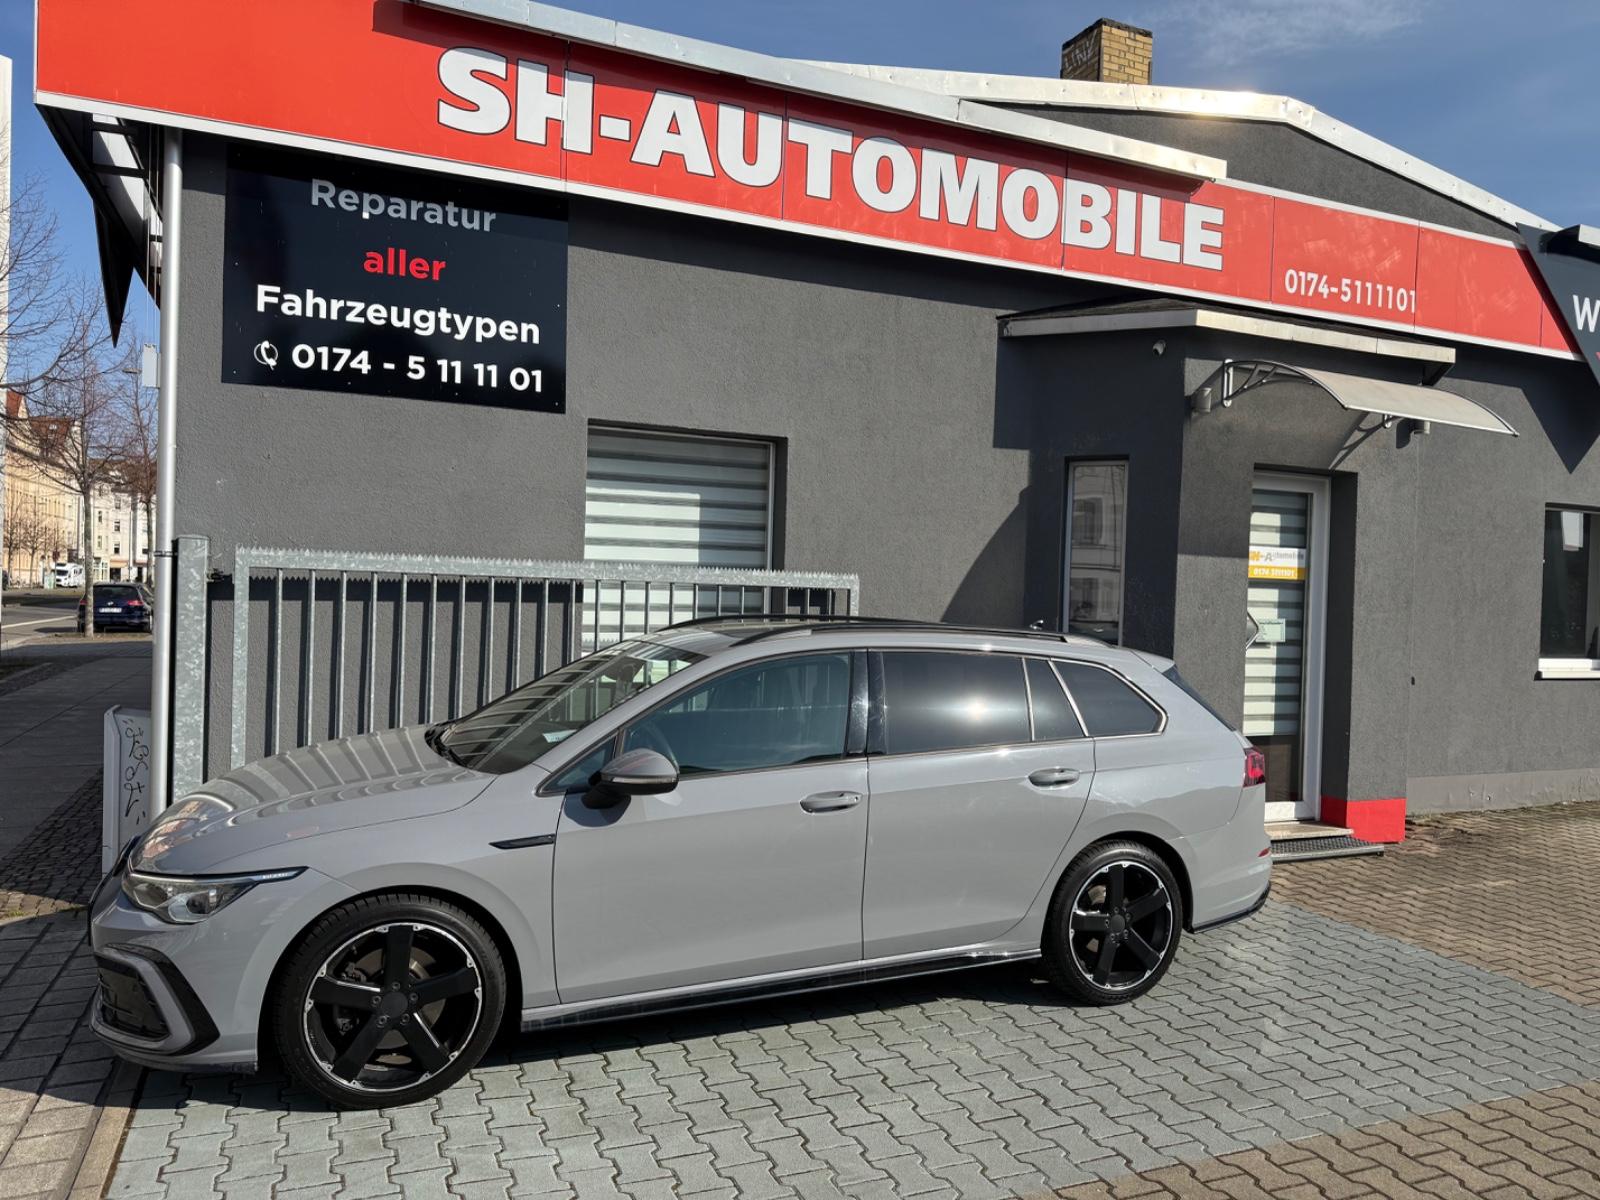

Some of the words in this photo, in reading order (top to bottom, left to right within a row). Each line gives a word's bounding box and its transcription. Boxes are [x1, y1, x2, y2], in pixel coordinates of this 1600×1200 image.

[437, 46, 1225, 271] SH-AUTOMOBILE
[311, 178, 497, 233] Reparatur
[363, 247, 447, 281] aller
[256, 284, 541, 344] Fahrzeugtypen
[1284, 268, 1416, 314] 0174-5111101
[291, 343, 371, 374] 0174
[406, 355, 426, 380] 5
[437, 359, 462, 384] 11
[473, 363, 498, 388] 11
[509, 367, 542, 393] 01
